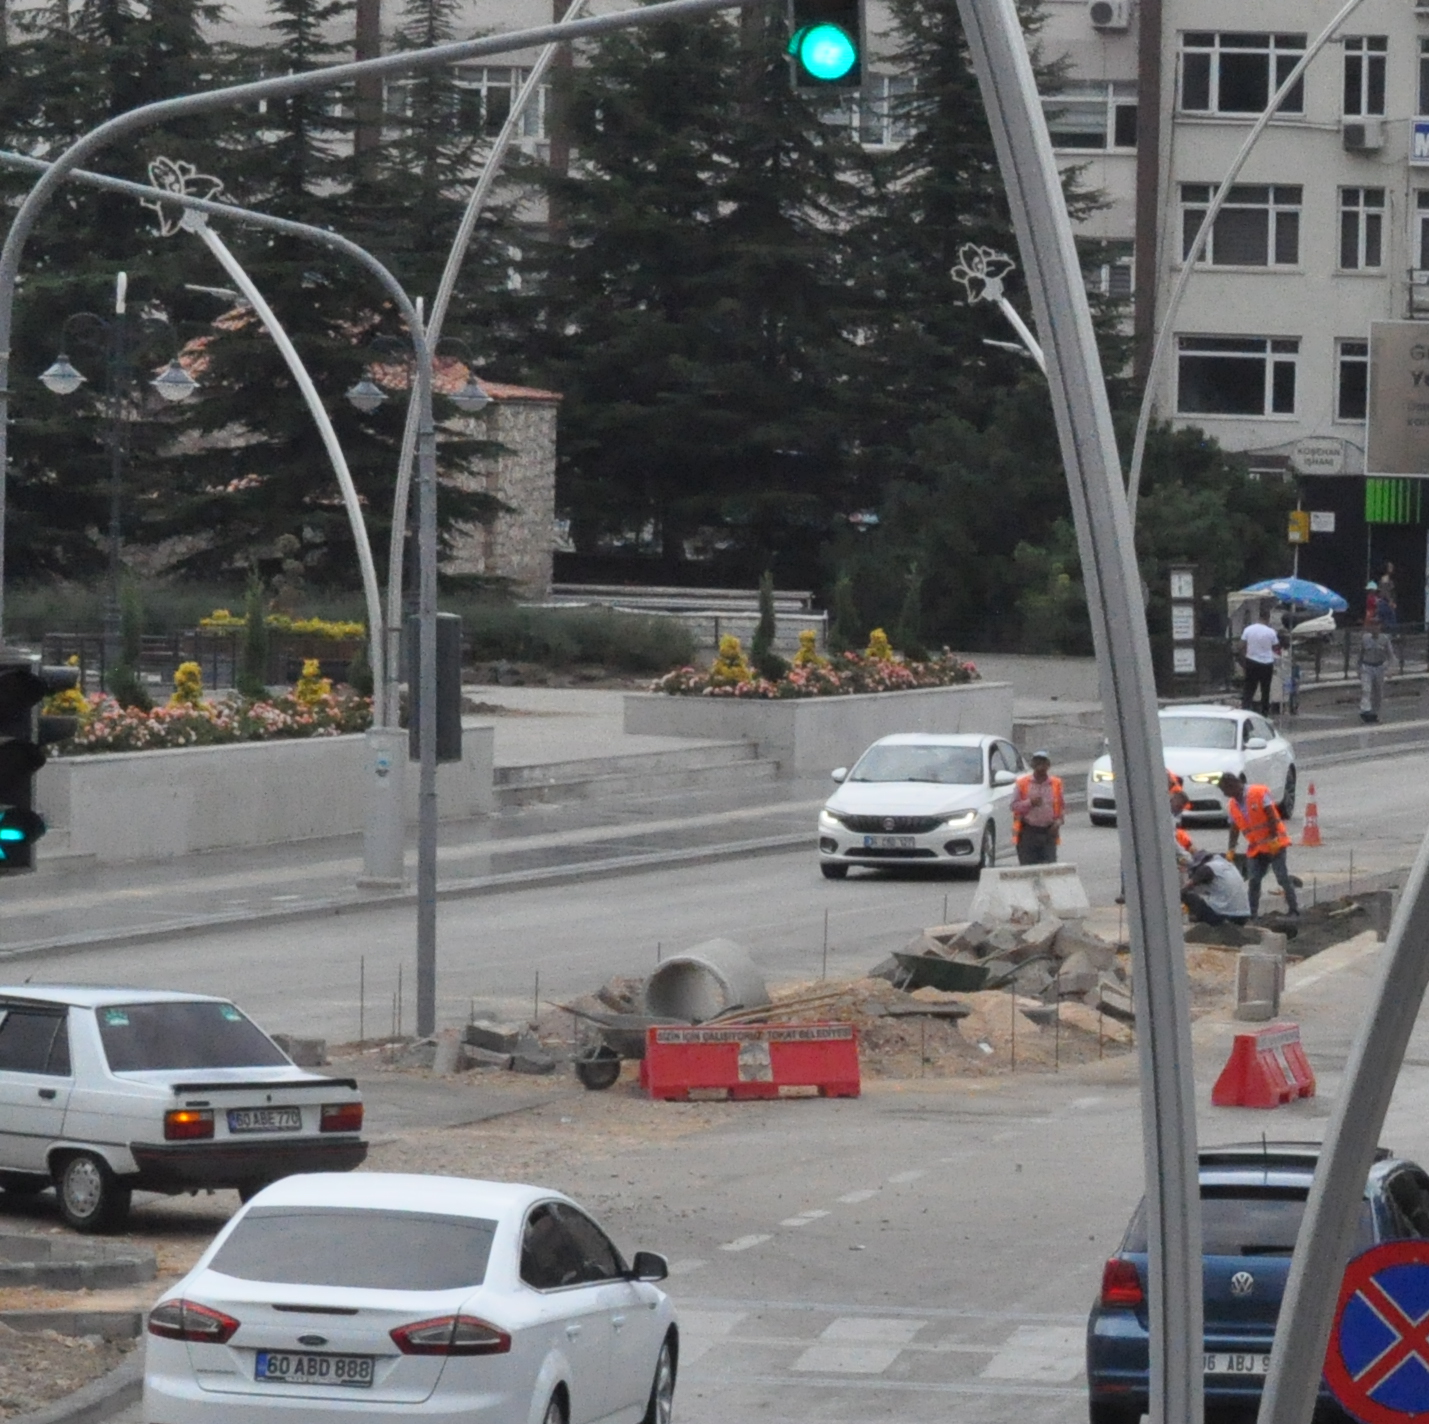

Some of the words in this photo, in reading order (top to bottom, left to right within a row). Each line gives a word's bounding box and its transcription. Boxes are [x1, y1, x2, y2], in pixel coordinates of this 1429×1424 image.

[236, 1111, 250, 1126] 60
[251, 1110, 277, 1126] ABE
[267, 1356, 291, 1375] 60
[293, 1357, 331, 1376] ABD
[334, 1359, 371, 1379] 888
[1227, 1354, 1255, 1371] ABJ
